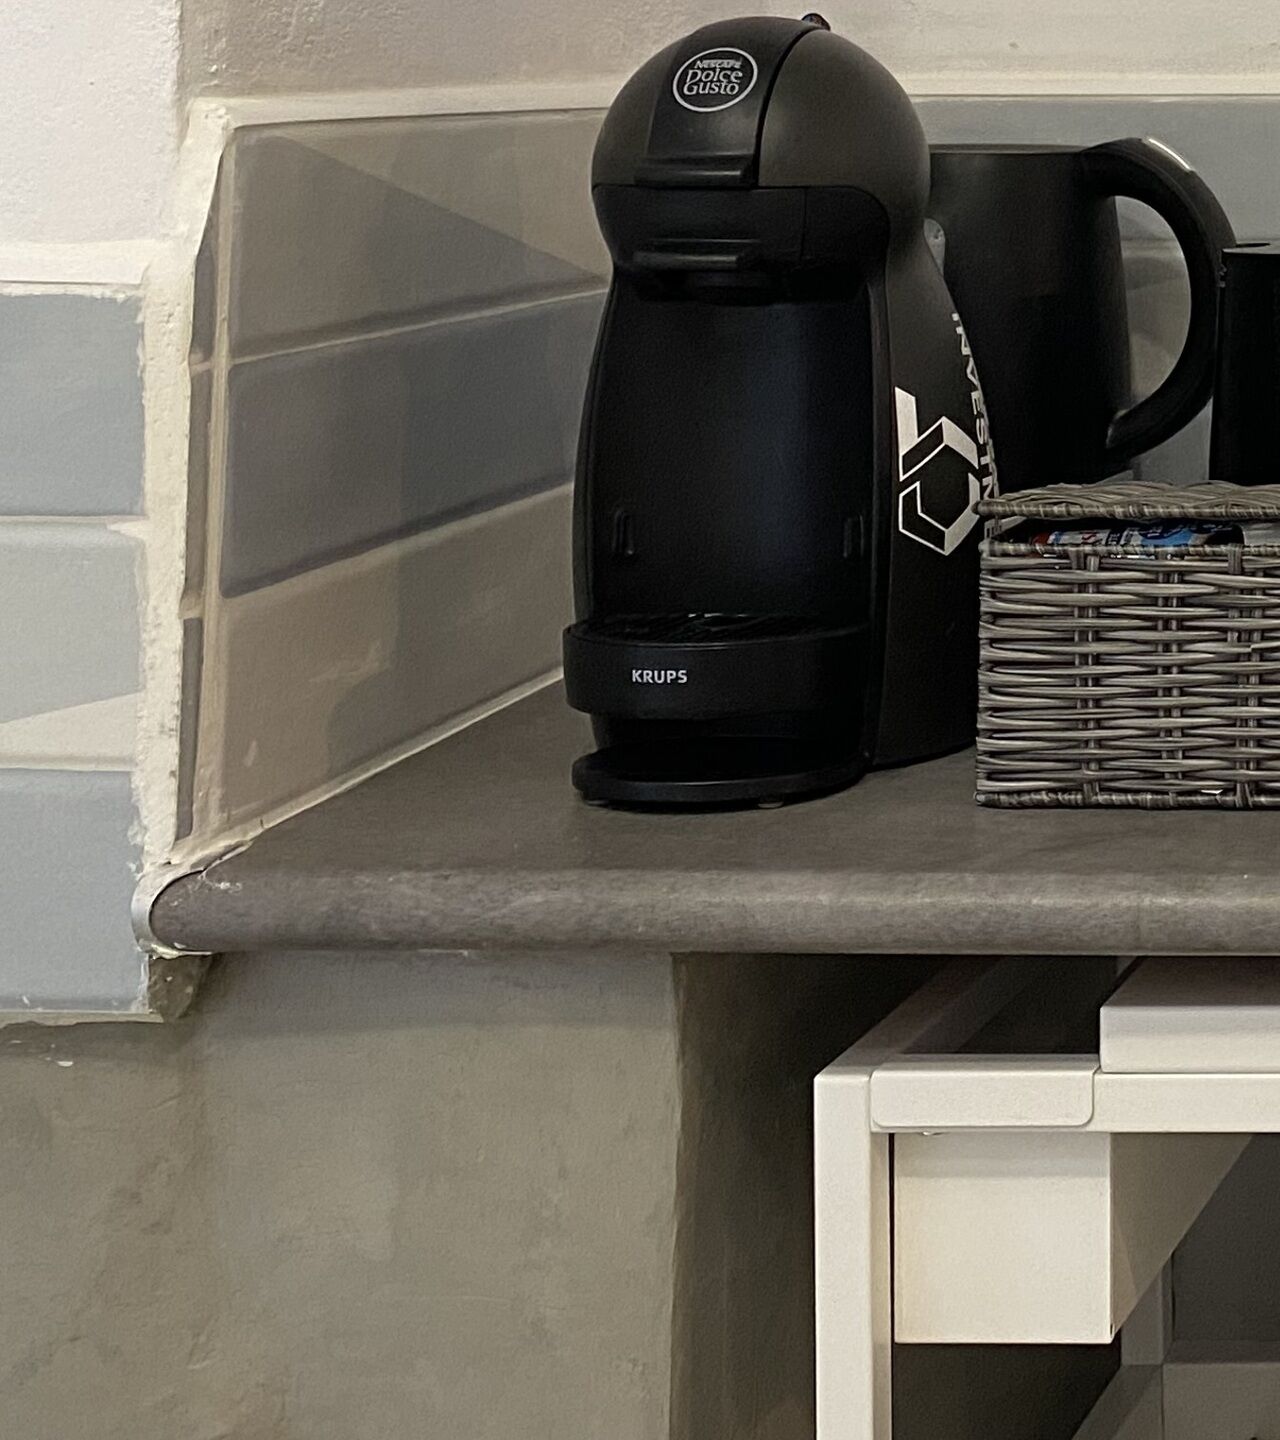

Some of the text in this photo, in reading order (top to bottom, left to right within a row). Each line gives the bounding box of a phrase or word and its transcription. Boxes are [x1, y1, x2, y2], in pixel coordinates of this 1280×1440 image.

[686, 68, 743, 83] Dolce
[683, 80, 739, 95] Gusto
[631, 668, 688, 684] KRUPS
